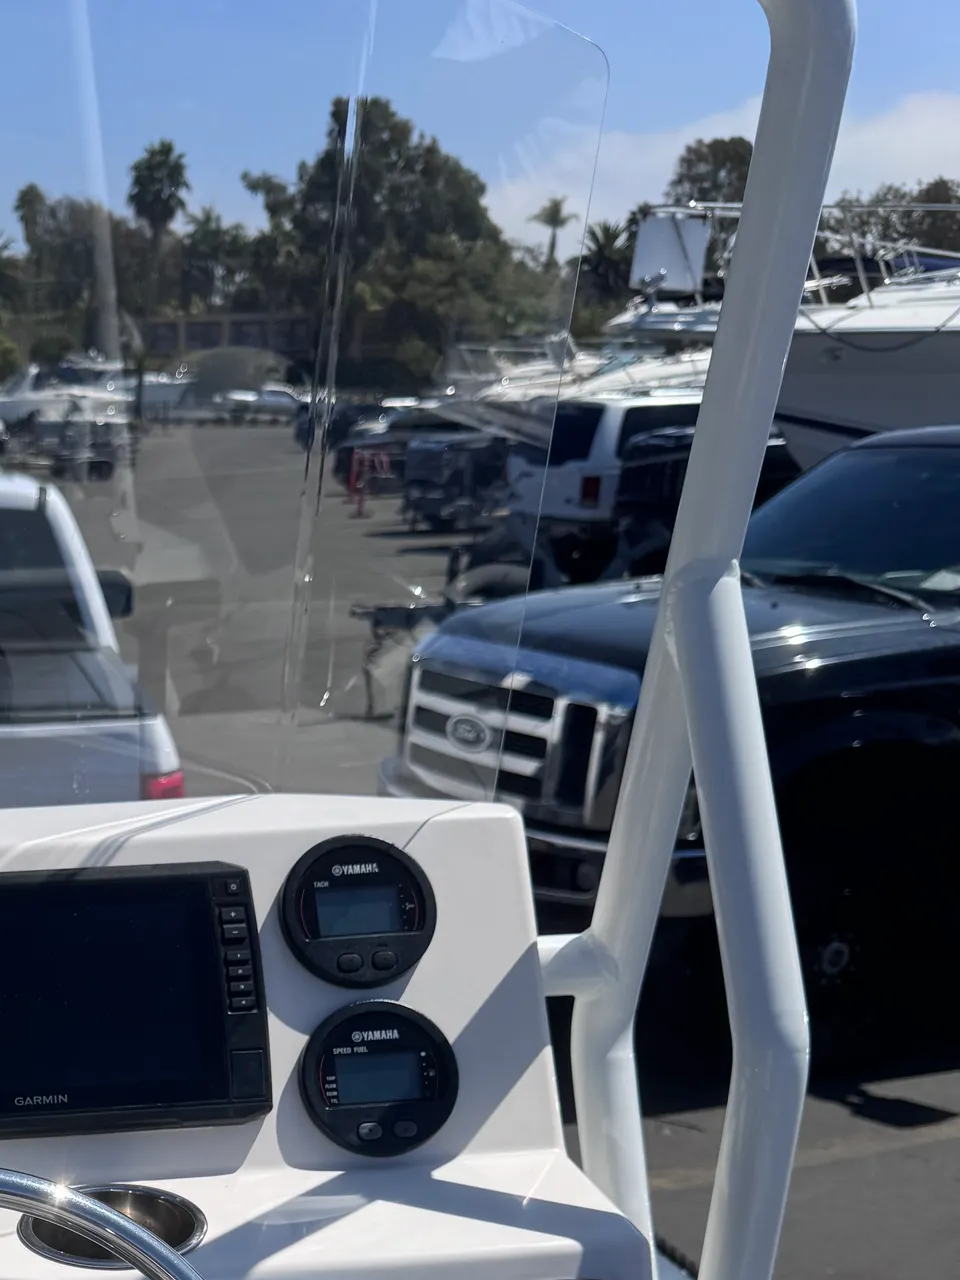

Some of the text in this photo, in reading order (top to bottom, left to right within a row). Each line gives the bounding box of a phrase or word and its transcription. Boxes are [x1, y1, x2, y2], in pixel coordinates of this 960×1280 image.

[342, 863, 379, 875] YAMAHA
[313, 880, 329, 888] TACH
[361, 1029, 400, 1041] YAMAHA
[332, 1045, 368, 1055] SPEED FUEL
[14, 1094, 68, 1106] GARMIN
